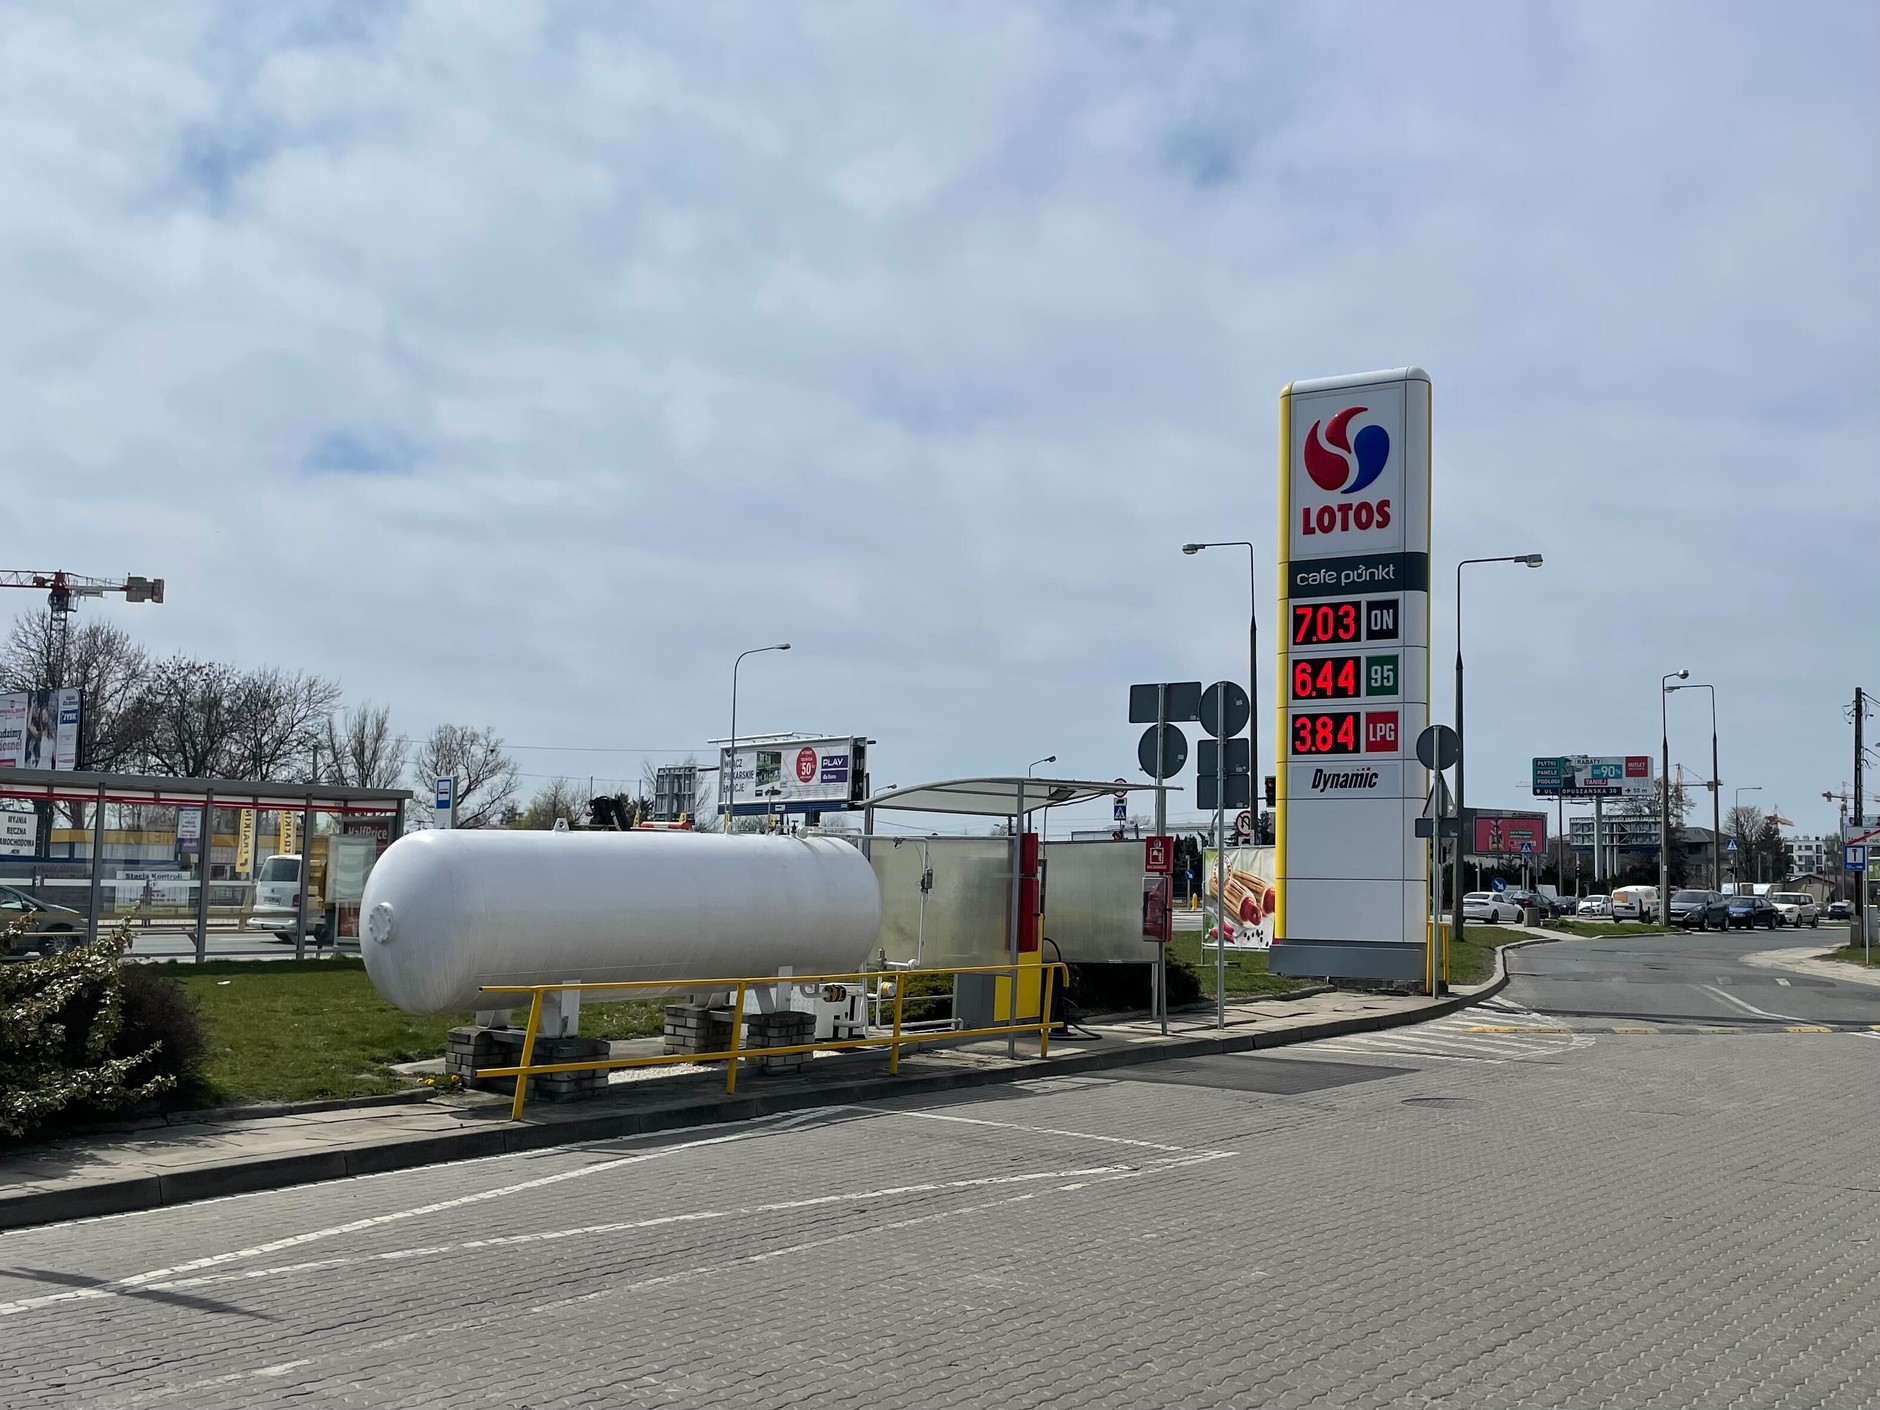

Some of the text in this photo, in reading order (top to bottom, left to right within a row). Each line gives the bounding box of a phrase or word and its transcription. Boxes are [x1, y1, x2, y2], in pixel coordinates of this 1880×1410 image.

[1302, 499, 1391, 535] LOTOS
[1296, 568, 1337, 586] cafe
[1295, 604, 1356, 643] 7.03
[1371, 609, 1394, 630] ON
[1294, 659, 1355, 697] 6.44
[1371, 665, 1394, 687] 95
[1294, 715, 1355, 752] 3.84
[1369, 723, 1395, 741] LPG
[801, 762, 811, 775] 50
[823, 758, 844, 767] PLAY
[1311, 767, 1379, 793] Dynamic
[8, 816, 27, 824] MYJNIA
